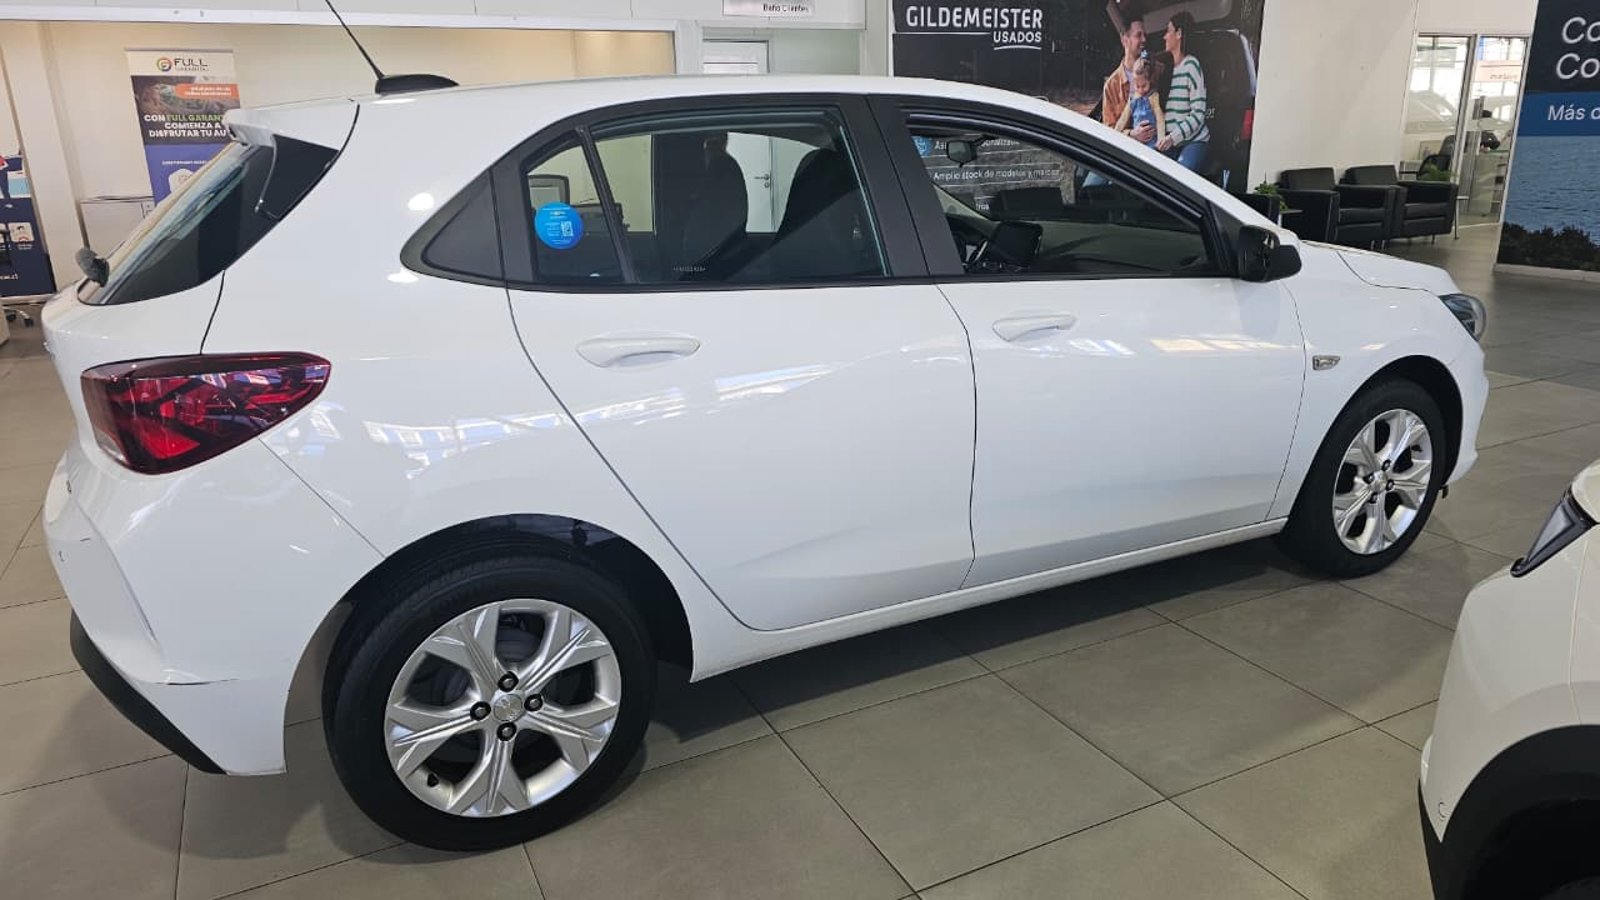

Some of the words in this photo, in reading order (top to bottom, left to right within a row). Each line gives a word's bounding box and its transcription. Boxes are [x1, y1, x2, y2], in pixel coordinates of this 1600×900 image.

[906, 6, 1043, 28] GILDEMEISTER
[993, 31, 1042, 43] USADOS
[174, 58, 208, 67] FULL
[1548, 104, 1585, 120] Más
[144, 114, 165, 122] CON
[166, 114, 188, 122] FULL
[164, 121, 213, 129] COMIENZA
[149, 129, 200, 137] DISFRUTAR
[200, 129, 212, 137] TU
[213, 129, 230, 137] AU
[933, 171, 961, 181] Amplio
[962, 169, 981, 179] stock
[984, 169, 995, 178] de
